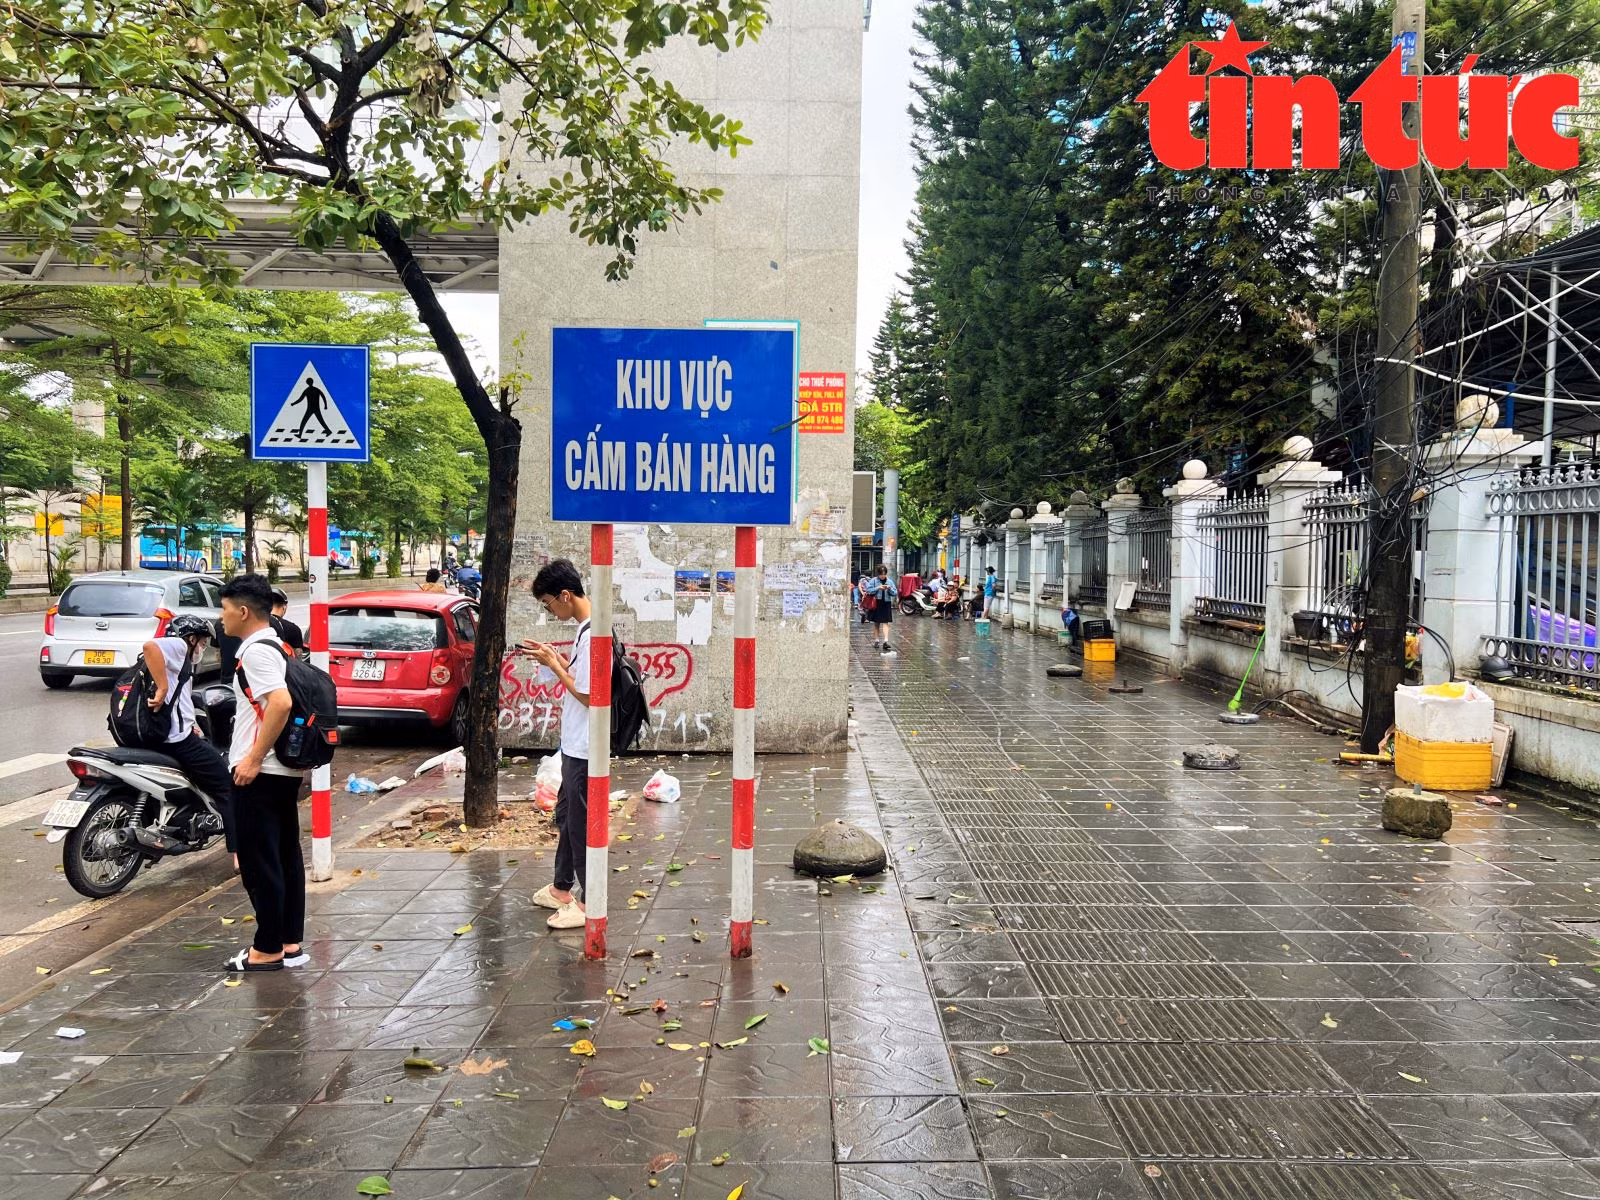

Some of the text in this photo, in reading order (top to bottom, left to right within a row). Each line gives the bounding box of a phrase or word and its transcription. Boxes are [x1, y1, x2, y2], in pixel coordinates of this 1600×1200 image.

[617, 355, 732, 418] KHU VỰC
[799, 400, 842, 412] GIÁ 5TR
[565, 424, 775, 494] CẤM BÁN HÀNG
[360, 660, 377, 669] 29A
